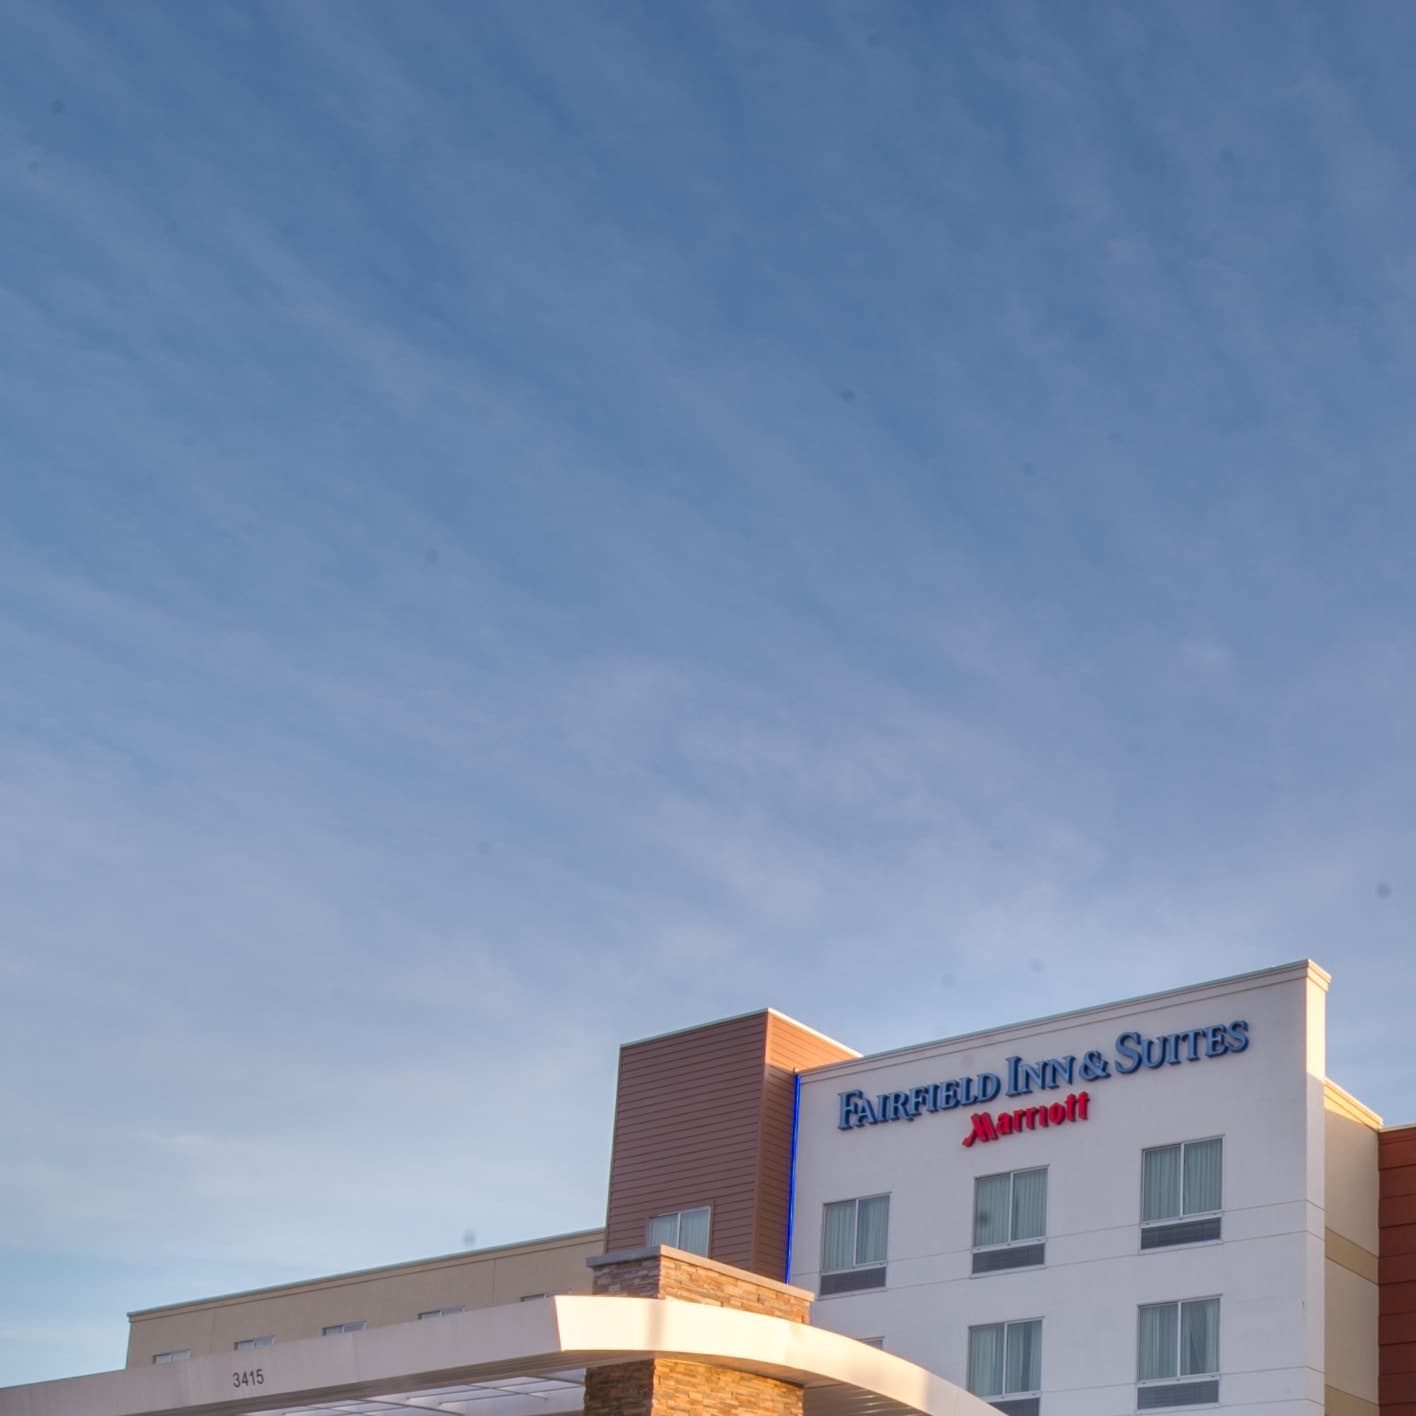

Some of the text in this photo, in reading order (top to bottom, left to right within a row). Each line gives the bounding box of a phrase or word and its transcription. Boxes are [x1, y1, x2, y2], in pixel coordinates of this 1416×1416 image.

[838, 1020, 1250, 1130] FAIRFIELD INN & SUITES
[961, 1091, 1090, 1148] Marriott
[232, 1368, 264, 1388] 3415
